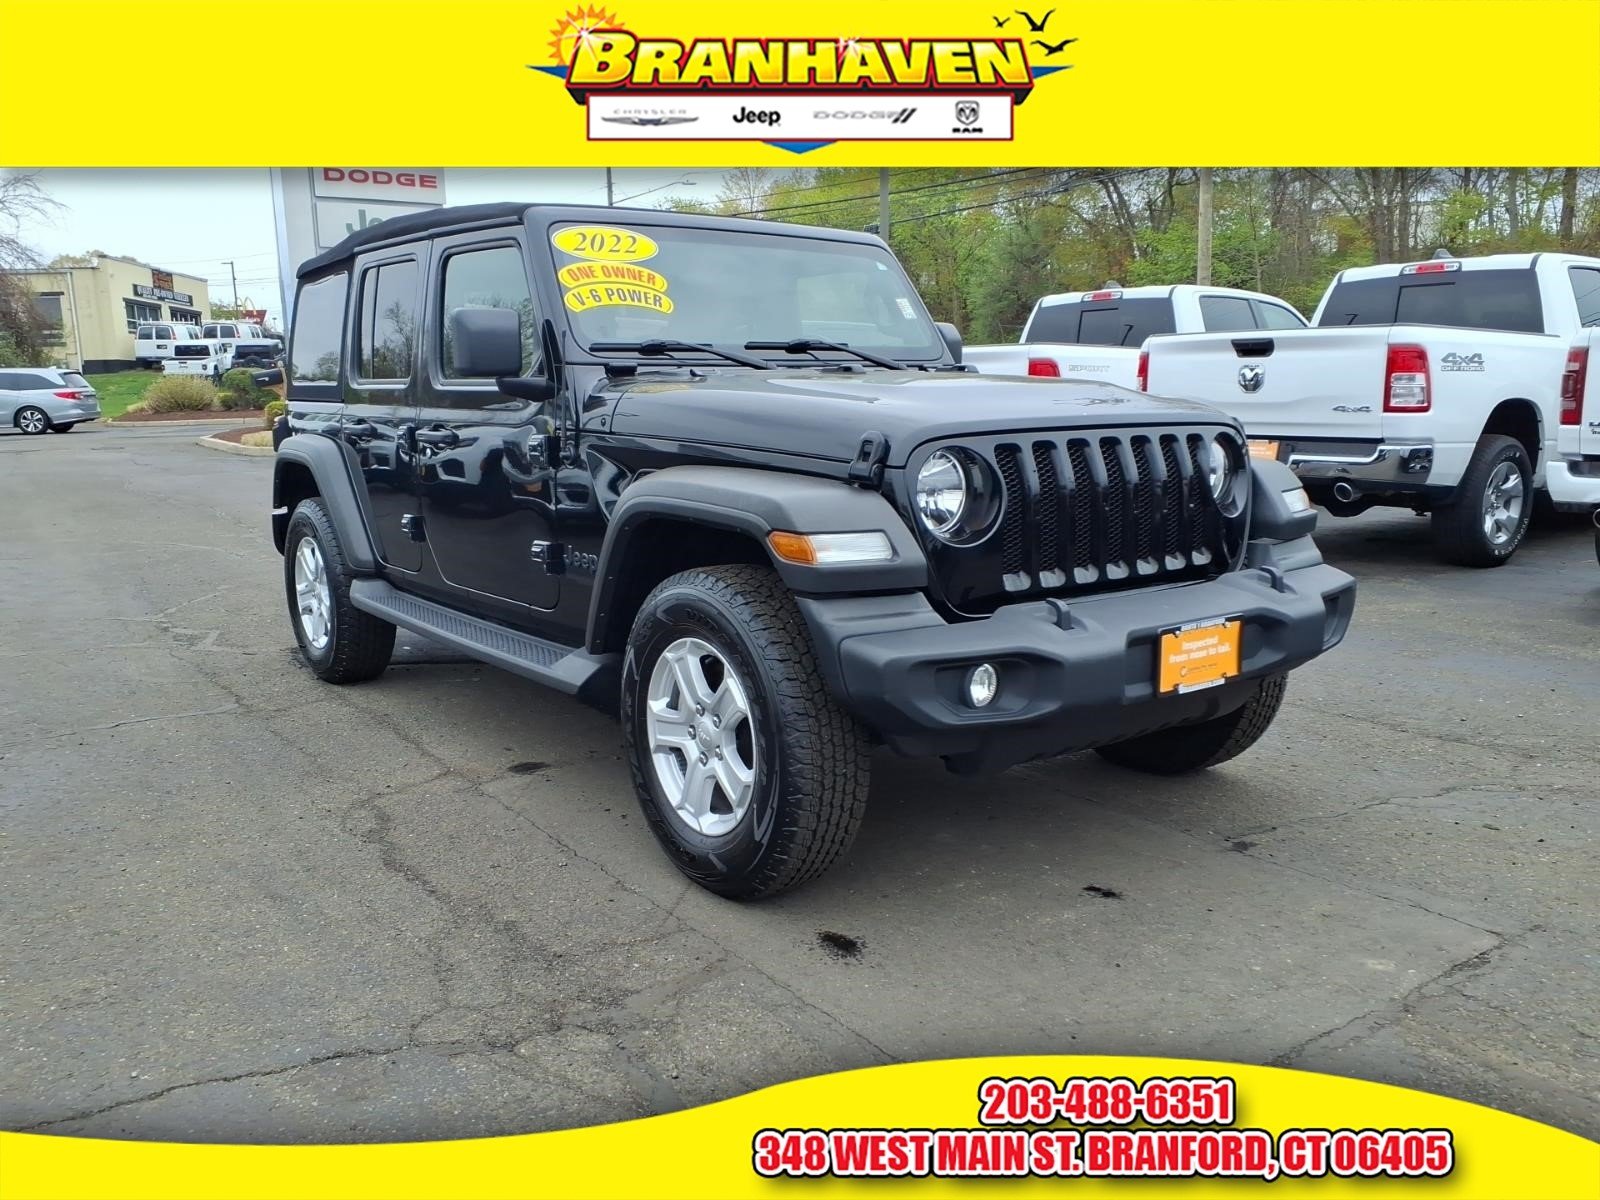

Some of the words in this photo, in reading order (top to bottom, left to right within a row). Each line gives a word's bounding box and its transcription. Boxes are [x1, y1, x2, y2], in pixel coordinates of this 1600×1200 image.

[323, 167, 438, 189] DODGE
[573, 232, 638, 254] 2022
[567, 265, 599, 282] ONE
[601, 265, 656, 286] OWNER
[572, 288, 602, 306] V-6
[605, 287, 662, 308] POWER
[1068, 364, 1111, 373] SPORT
[562, 544, 600, 577] Jeep
